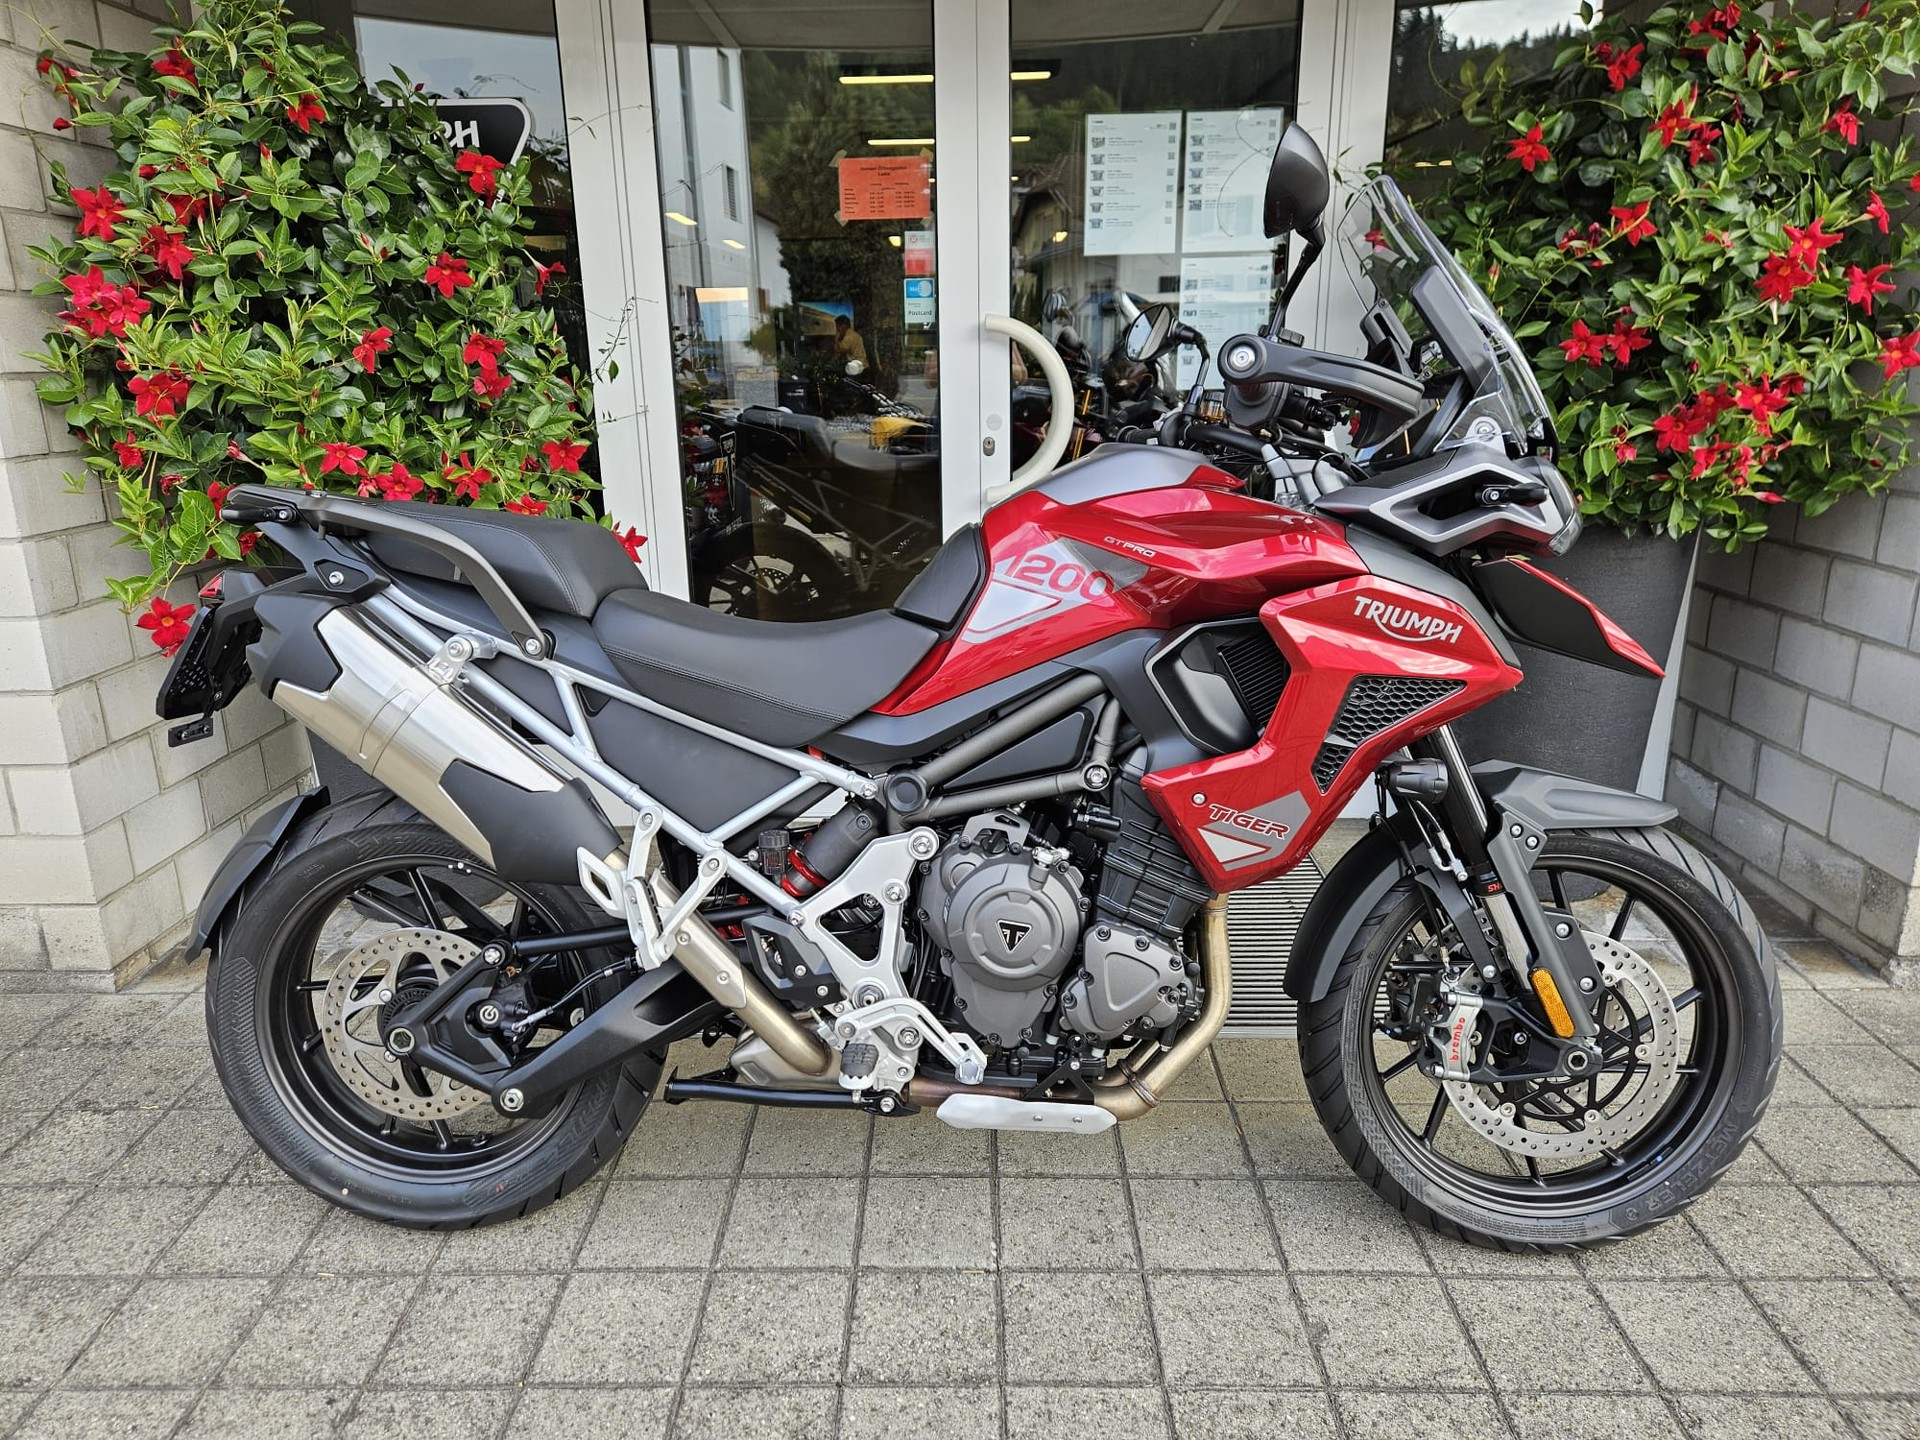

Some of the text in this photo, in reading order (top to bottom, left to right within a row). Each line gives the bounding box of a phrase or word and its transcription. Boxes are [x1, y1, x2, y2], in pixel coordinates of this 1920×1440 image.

[1005, 550, 1115, 601] 1200
[1353, 595, 1463, 644] TRIUMPH
[1208, 803, 1290, 840] TIGER
[1449, 1017, 1466, 1061] brembo
